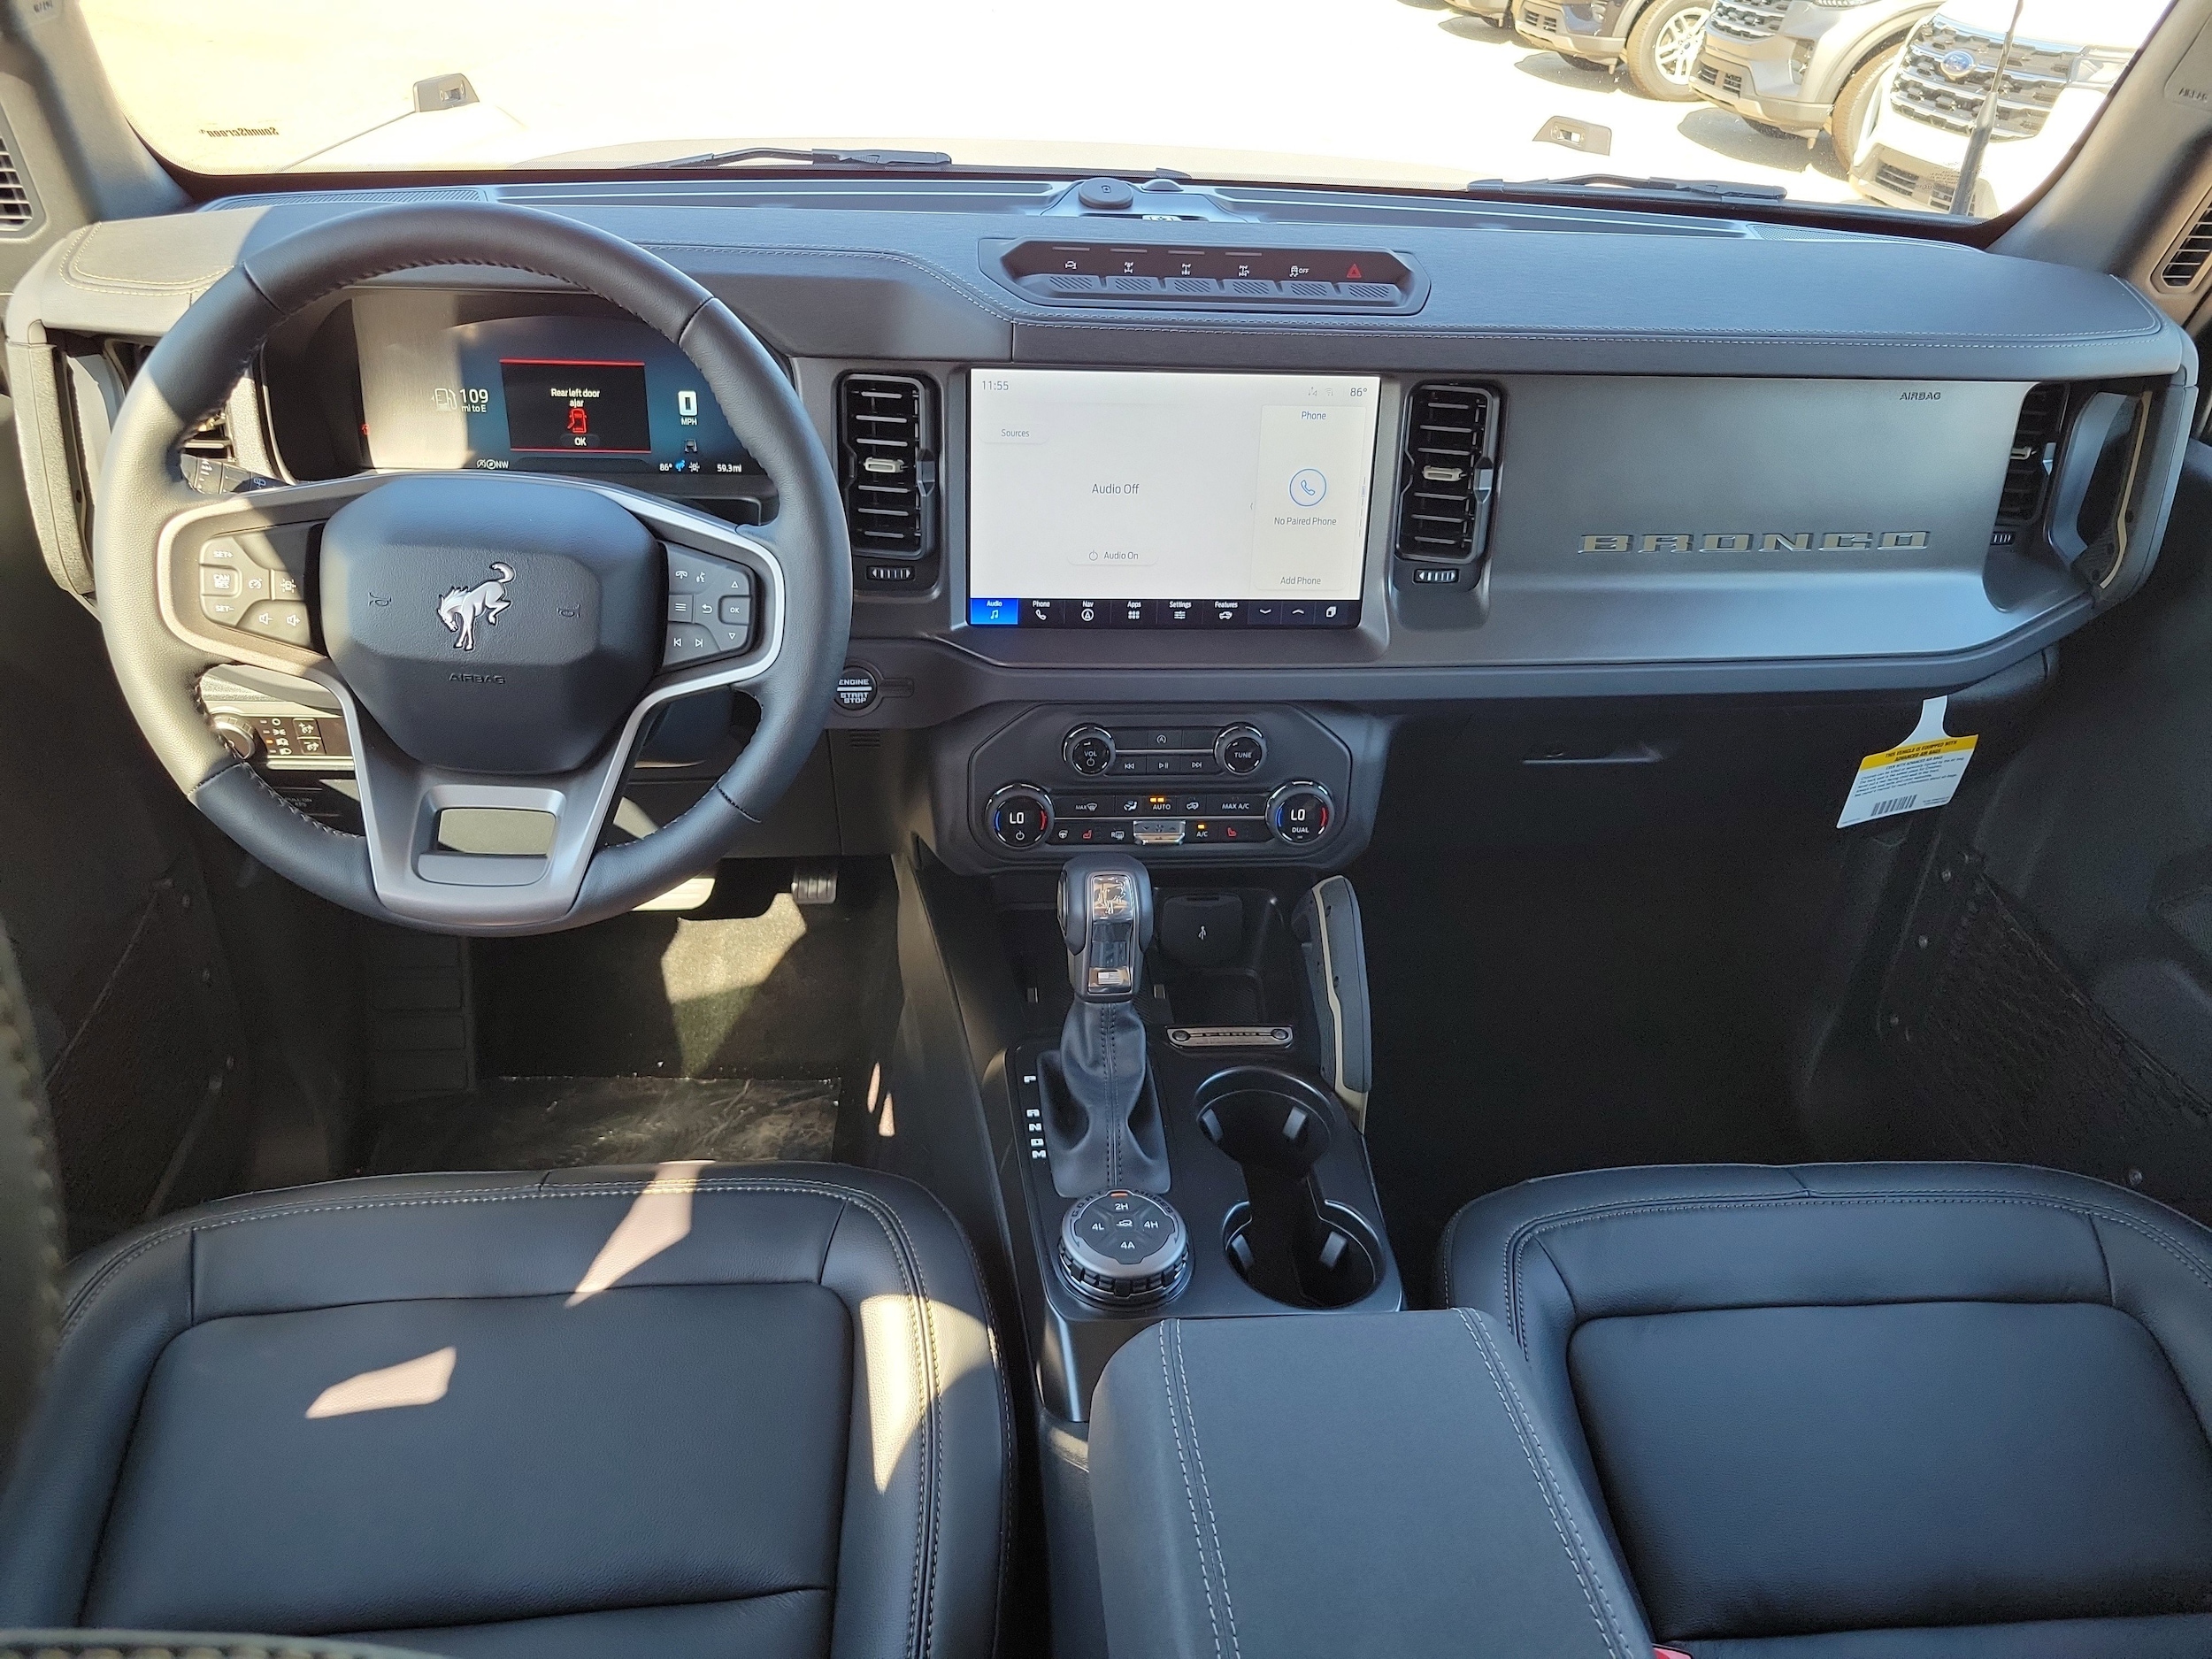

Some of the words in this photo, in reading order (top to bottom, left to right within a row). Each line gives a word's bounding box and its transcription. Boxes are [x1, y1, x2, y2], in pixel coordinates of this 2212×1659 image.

[982, 380, 1010, 390] 11:55
[459, 388, 489, 403] 109
[550, 388, 568, 397] Rear
[569, 388, 582, 397] left
[582, 388, 601, 398] door
[1350, 388, 1368, 397] 86°
[1900, 391, 1941, 401] AIRBAG
[569, 398, 584, 408] ajar
[678, 390, 697, 416] 0
[472, 403, 480, 413] to
[1302, 411, 1327, 420] Phone
[574, 437, 587, 446] OK
[659, 463, 672, 472] 86°
[717, 464, 733, 472] 59.3
[1092, 483, 1122, 495] Audio
[1124, 483, 1140, 495] Off
[1286, 517, 1311, 526] Paired
[1578, 531, 1931, 554] BRONCO
[1104, 551, 1126, 560] Audio
[449, 672, 506, 684] AIRBAG
[1009, 811, 1025, 825] LO
[1290, 809, 1306, 821] LO
[1196, 829, 1209, 838] A/C
[1026, 1109, 1040, 1118] R
[1028, 1123, 1042, 1132] N
[1030, 1138, 1044, 1147] D
[1032, 1150, 1047, 1159] M
